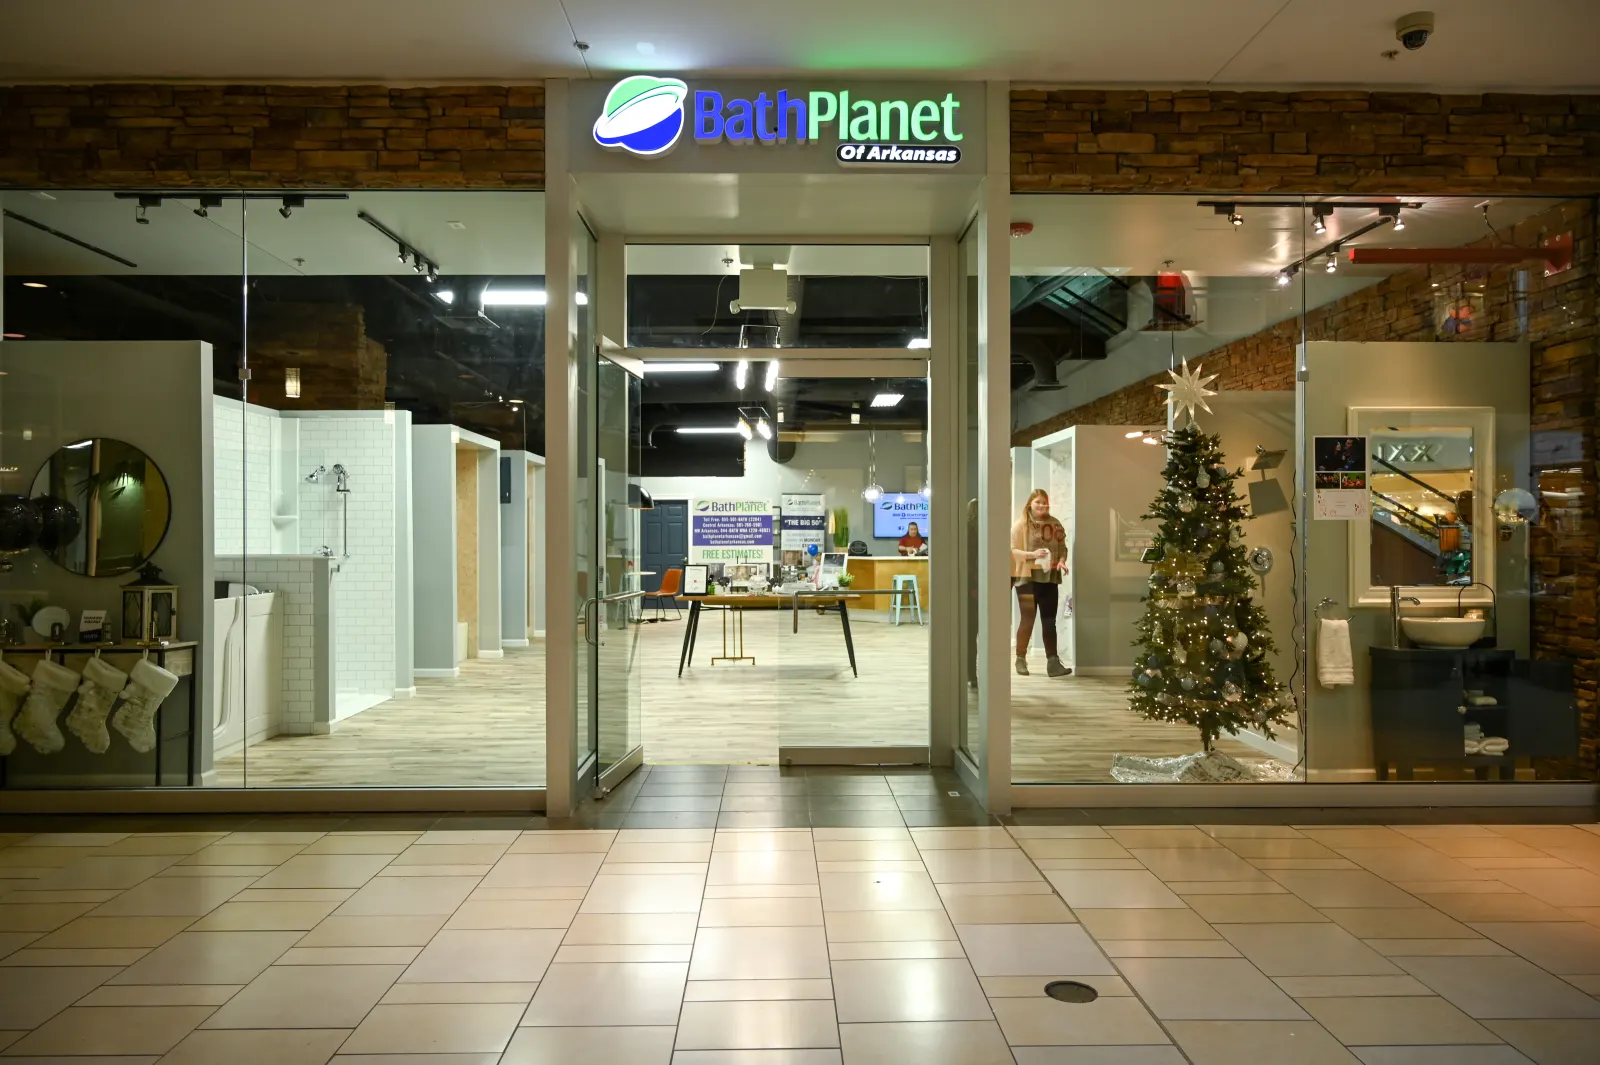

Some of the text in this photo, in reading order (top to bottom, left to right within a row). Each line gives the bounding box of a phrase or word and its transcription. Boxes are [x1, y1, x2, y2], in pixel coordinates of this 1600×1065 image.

[694, 89, 964, 143] BathPlanet
[840, 145, 958, 163] Of Arkansas
[711, 501, 768, 512] BathPlanet
[894, 502, 929, 511] BathPla
[702, 549, 764, 559] FREE ESTIMATES!
